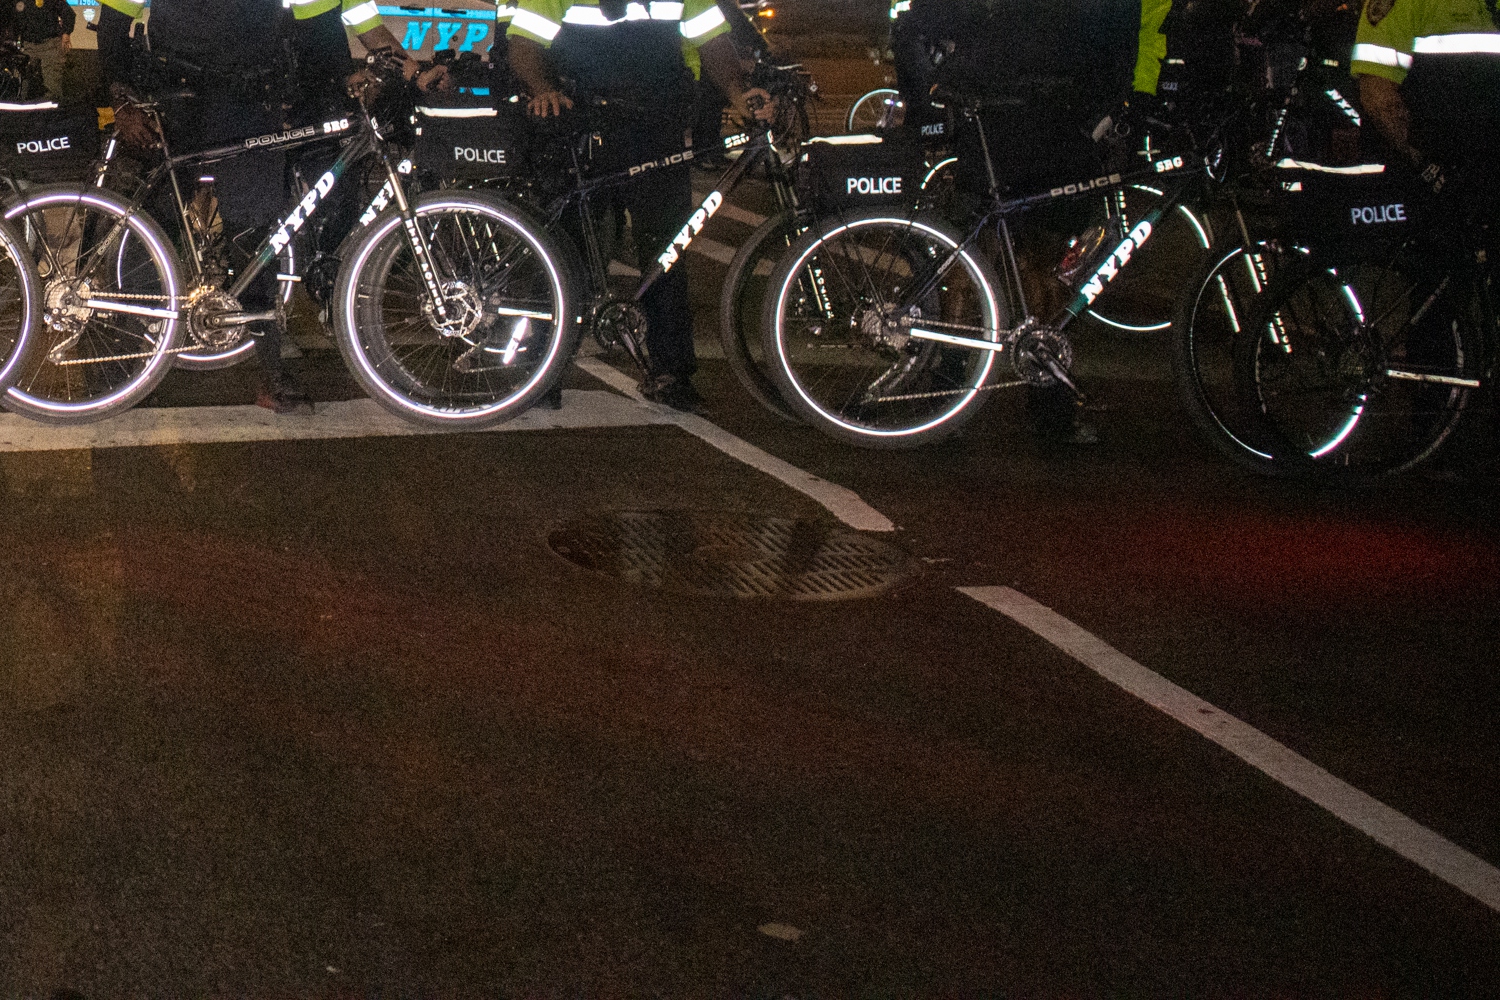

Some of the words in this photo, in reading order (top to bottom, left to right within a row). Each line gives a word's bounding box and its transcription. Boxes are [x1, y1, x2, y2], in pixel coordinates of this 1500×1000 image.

[401, 21, 493, 52] NYP
[16, 136, 71, 154] POLICE
[246, 125, 316, 149] POLICE
[323, 118, 350, 134] SRG
[921, 123, 945, 136] POLICE
[454, 146, 507, 164] POLICE
[846, 177, 902, 195] POLICE
[1050, 173, 1122, 198] POLICE
[1155, 156, 1184, 173] SRG
[269, 171, 335, 256] NYPD
[1351, 203, 1407, 225] POLICE
[657, 190, 723, 274] NYPD
[405, 218, 423, 256] NYPD
[421, 262, 447, 317] POLICE
[1080, 220, 1153, 305] NYPD
